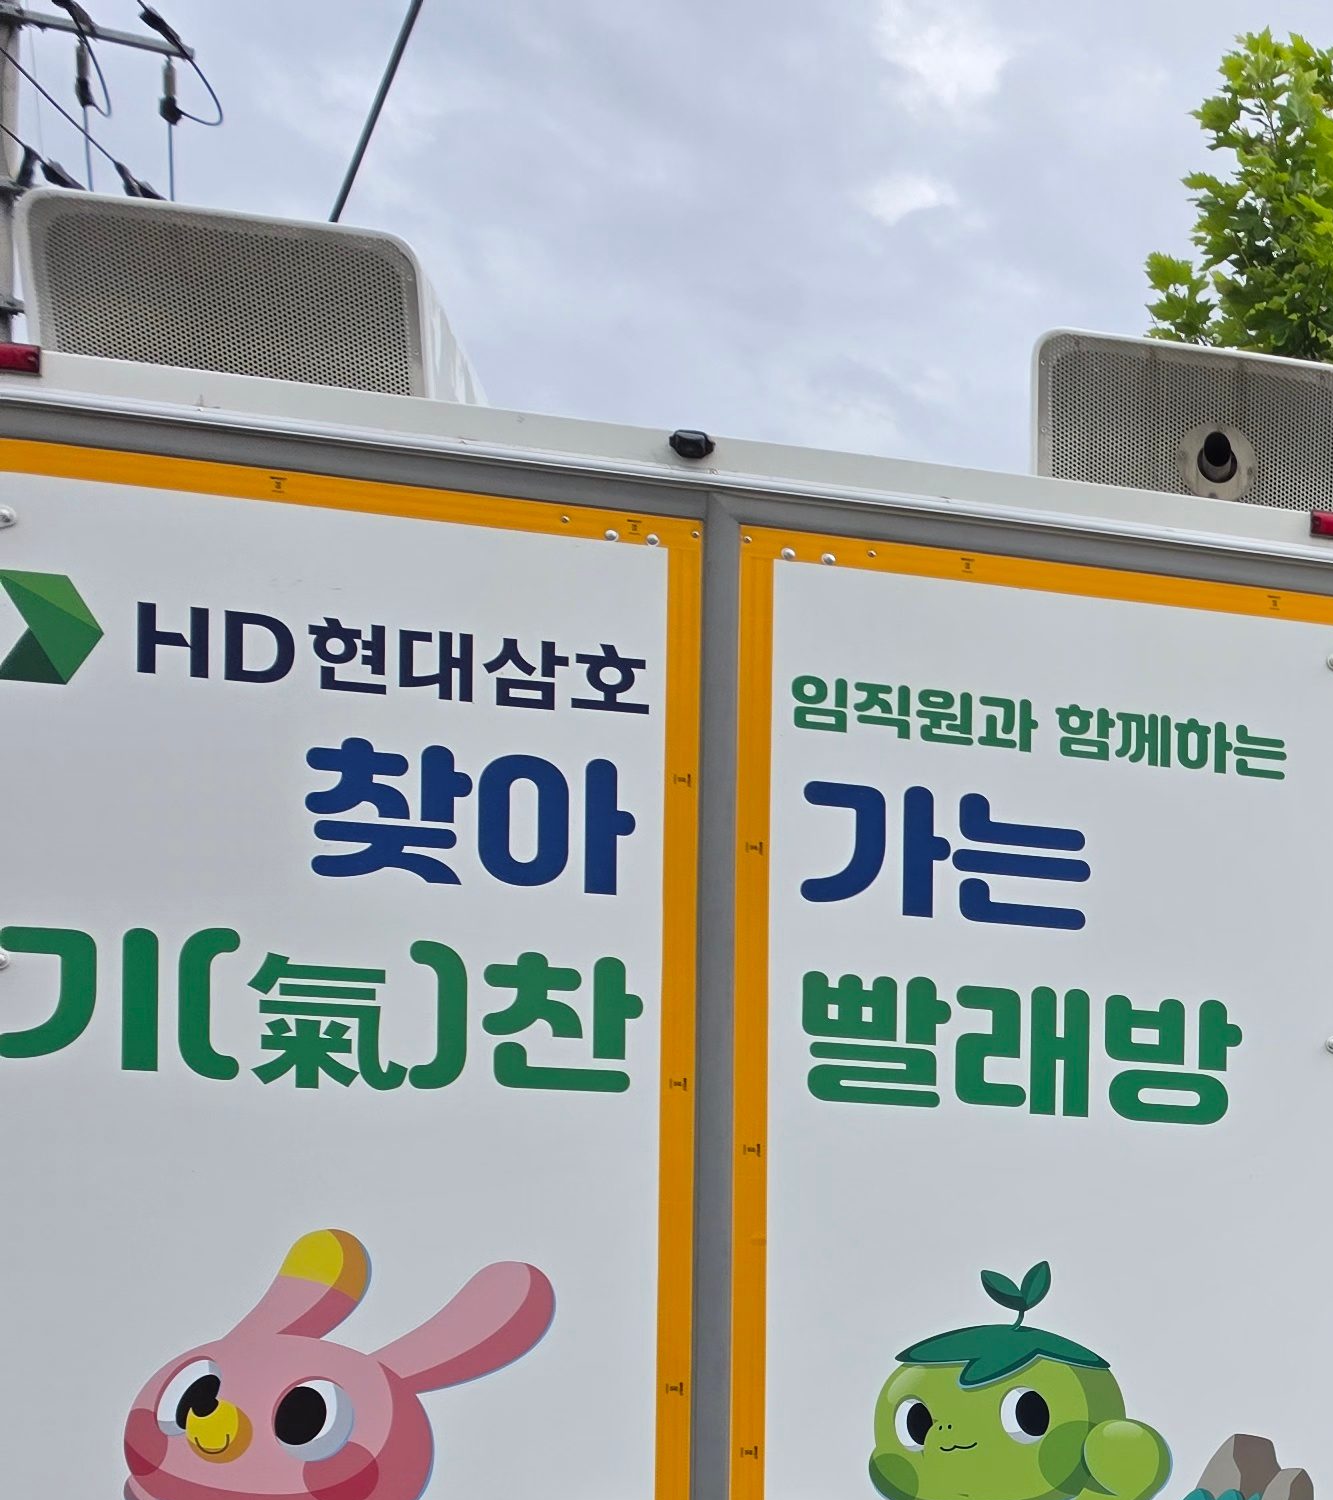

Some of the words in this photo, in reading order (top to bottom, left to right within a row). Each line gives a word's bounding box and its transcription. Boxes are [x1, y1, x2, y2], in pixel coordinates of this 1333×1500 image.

[137, 602, 649, 714] HD현대삼호
[792, 675, 1038, 752] 임직원과
[1055, 704, 1287, 780] 함께하는
[304, 737, 636, 895] 찾아
[800, 780, 1091, 930] 가는
[802, 971, 1242, 1125] 빨래방
